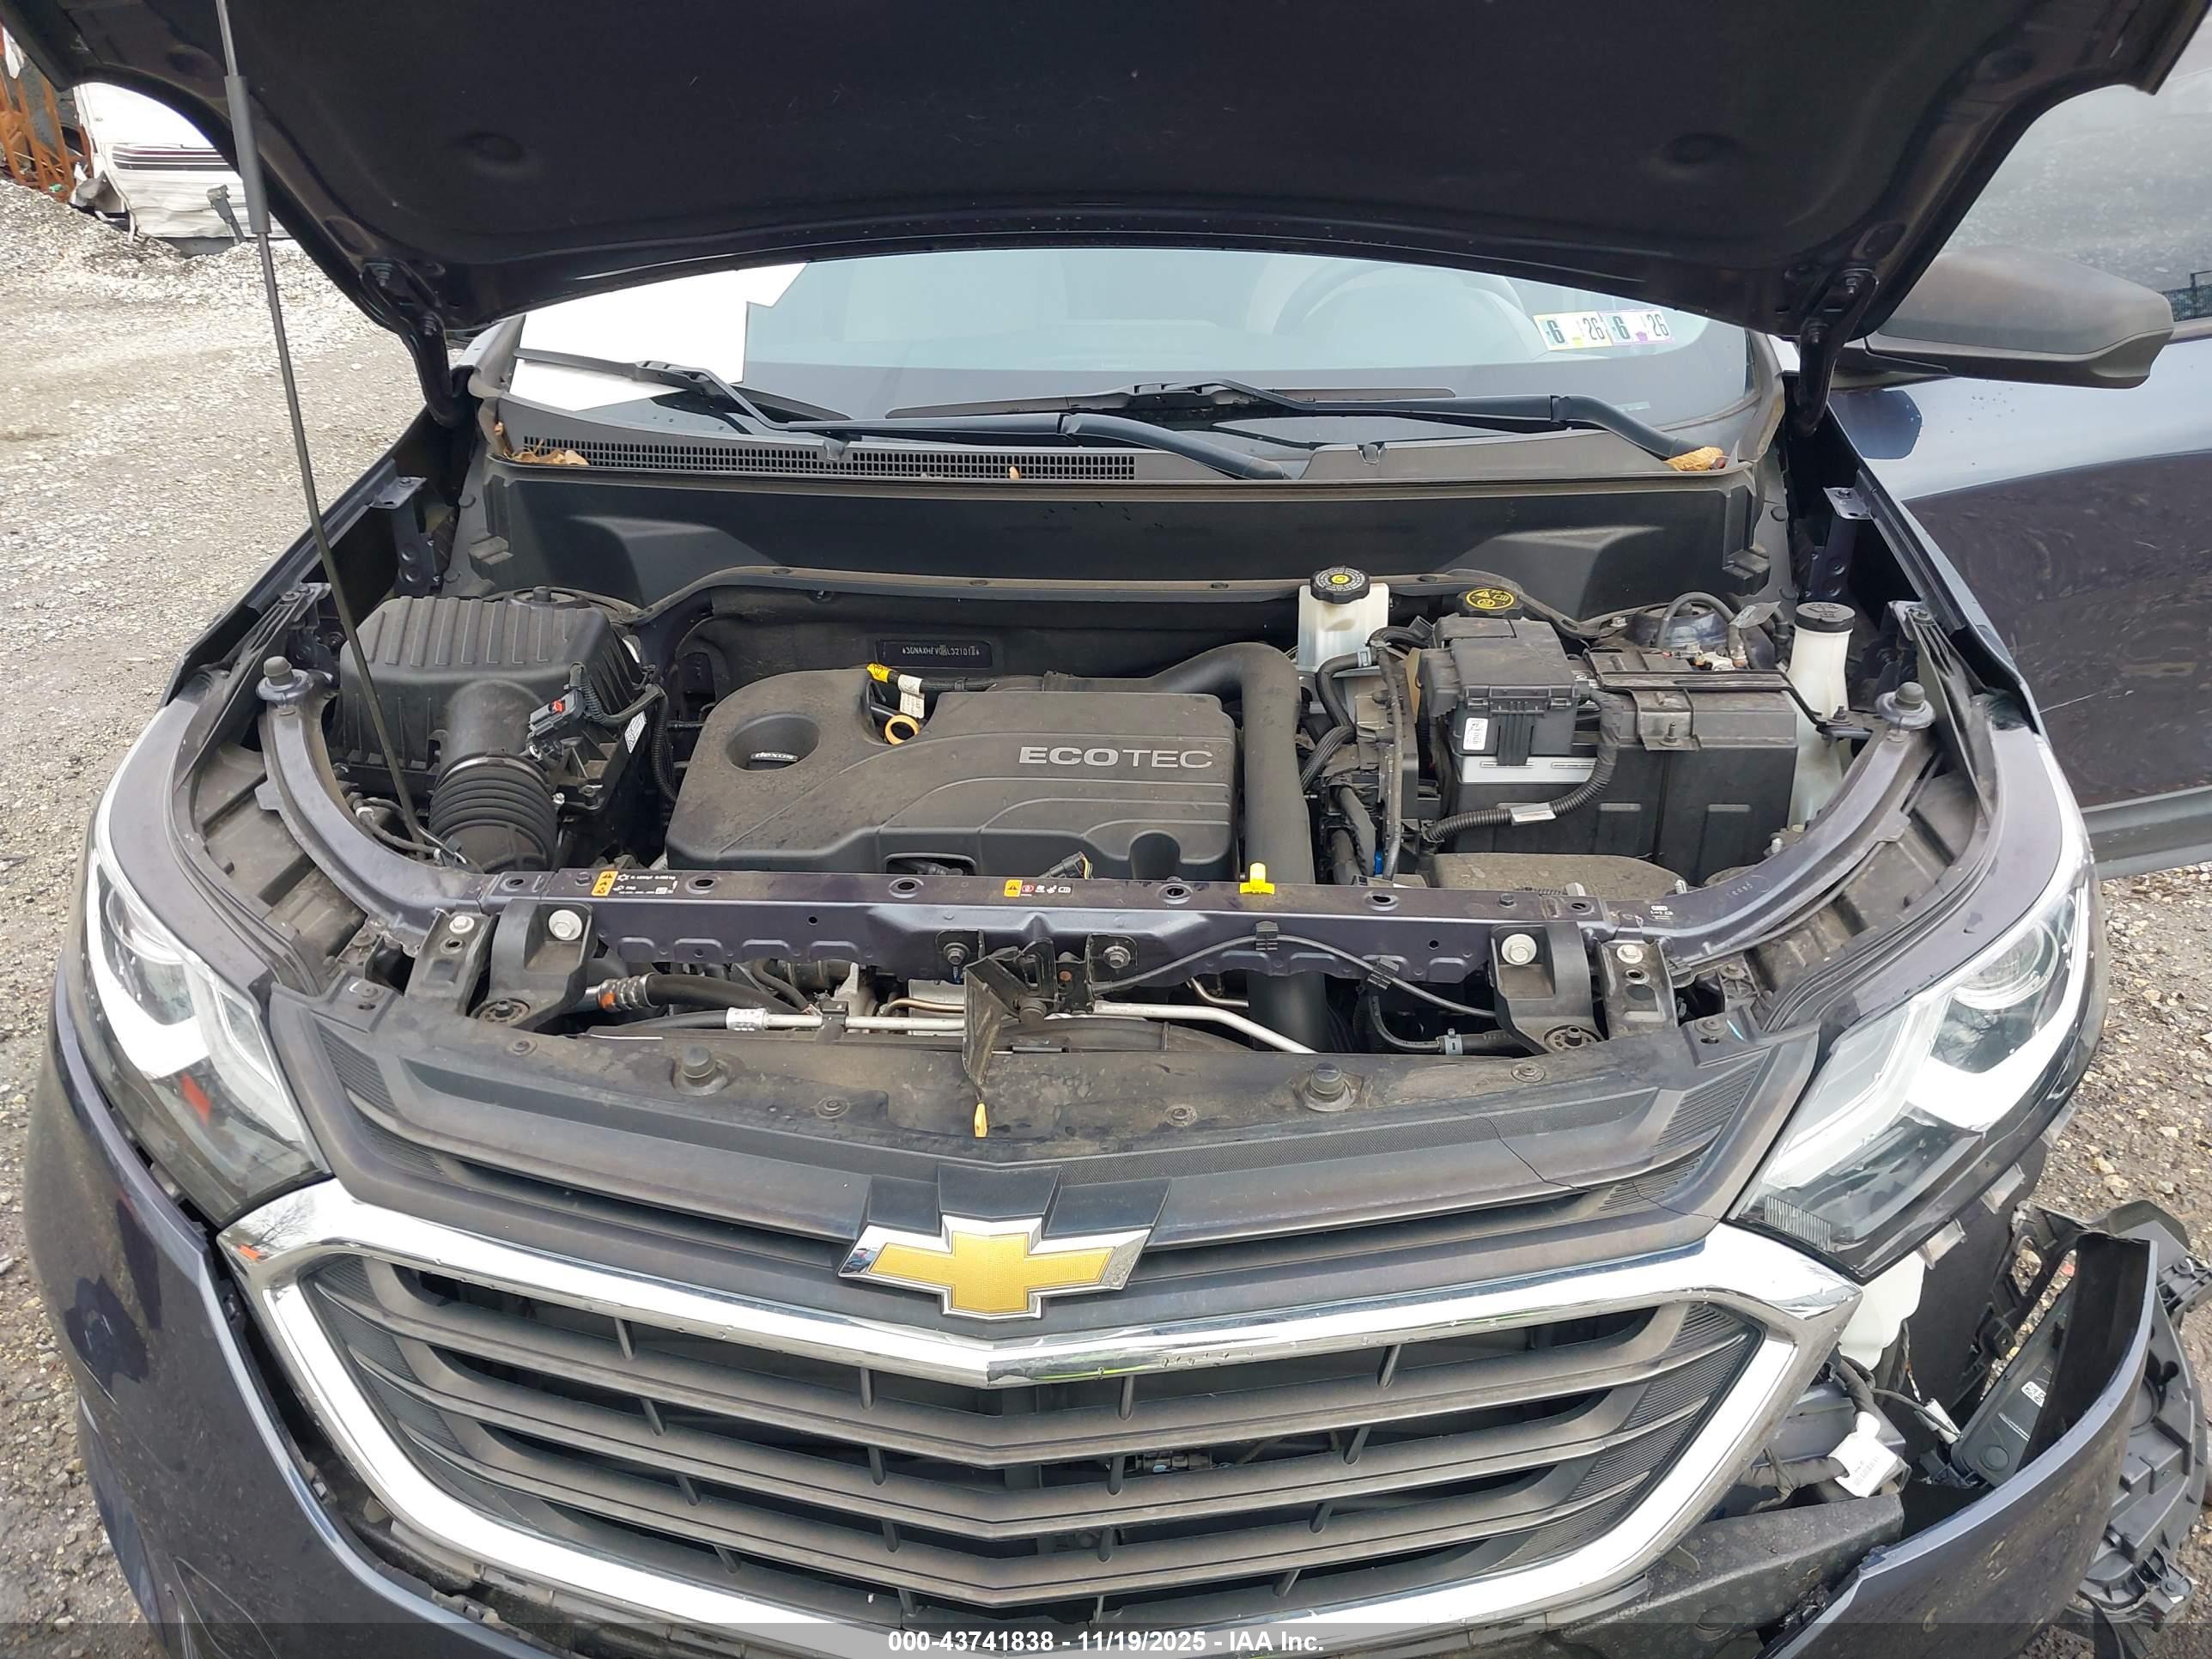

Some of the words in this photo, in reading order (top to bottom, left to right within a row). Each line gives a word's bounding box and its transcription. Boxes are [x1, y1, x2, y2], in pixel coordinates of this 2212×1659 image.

[1583, 317, 1606, 341] 26
[1647, 313, 1669, 337] 26
[1018, 746, 1213, 769] ECOTEC
